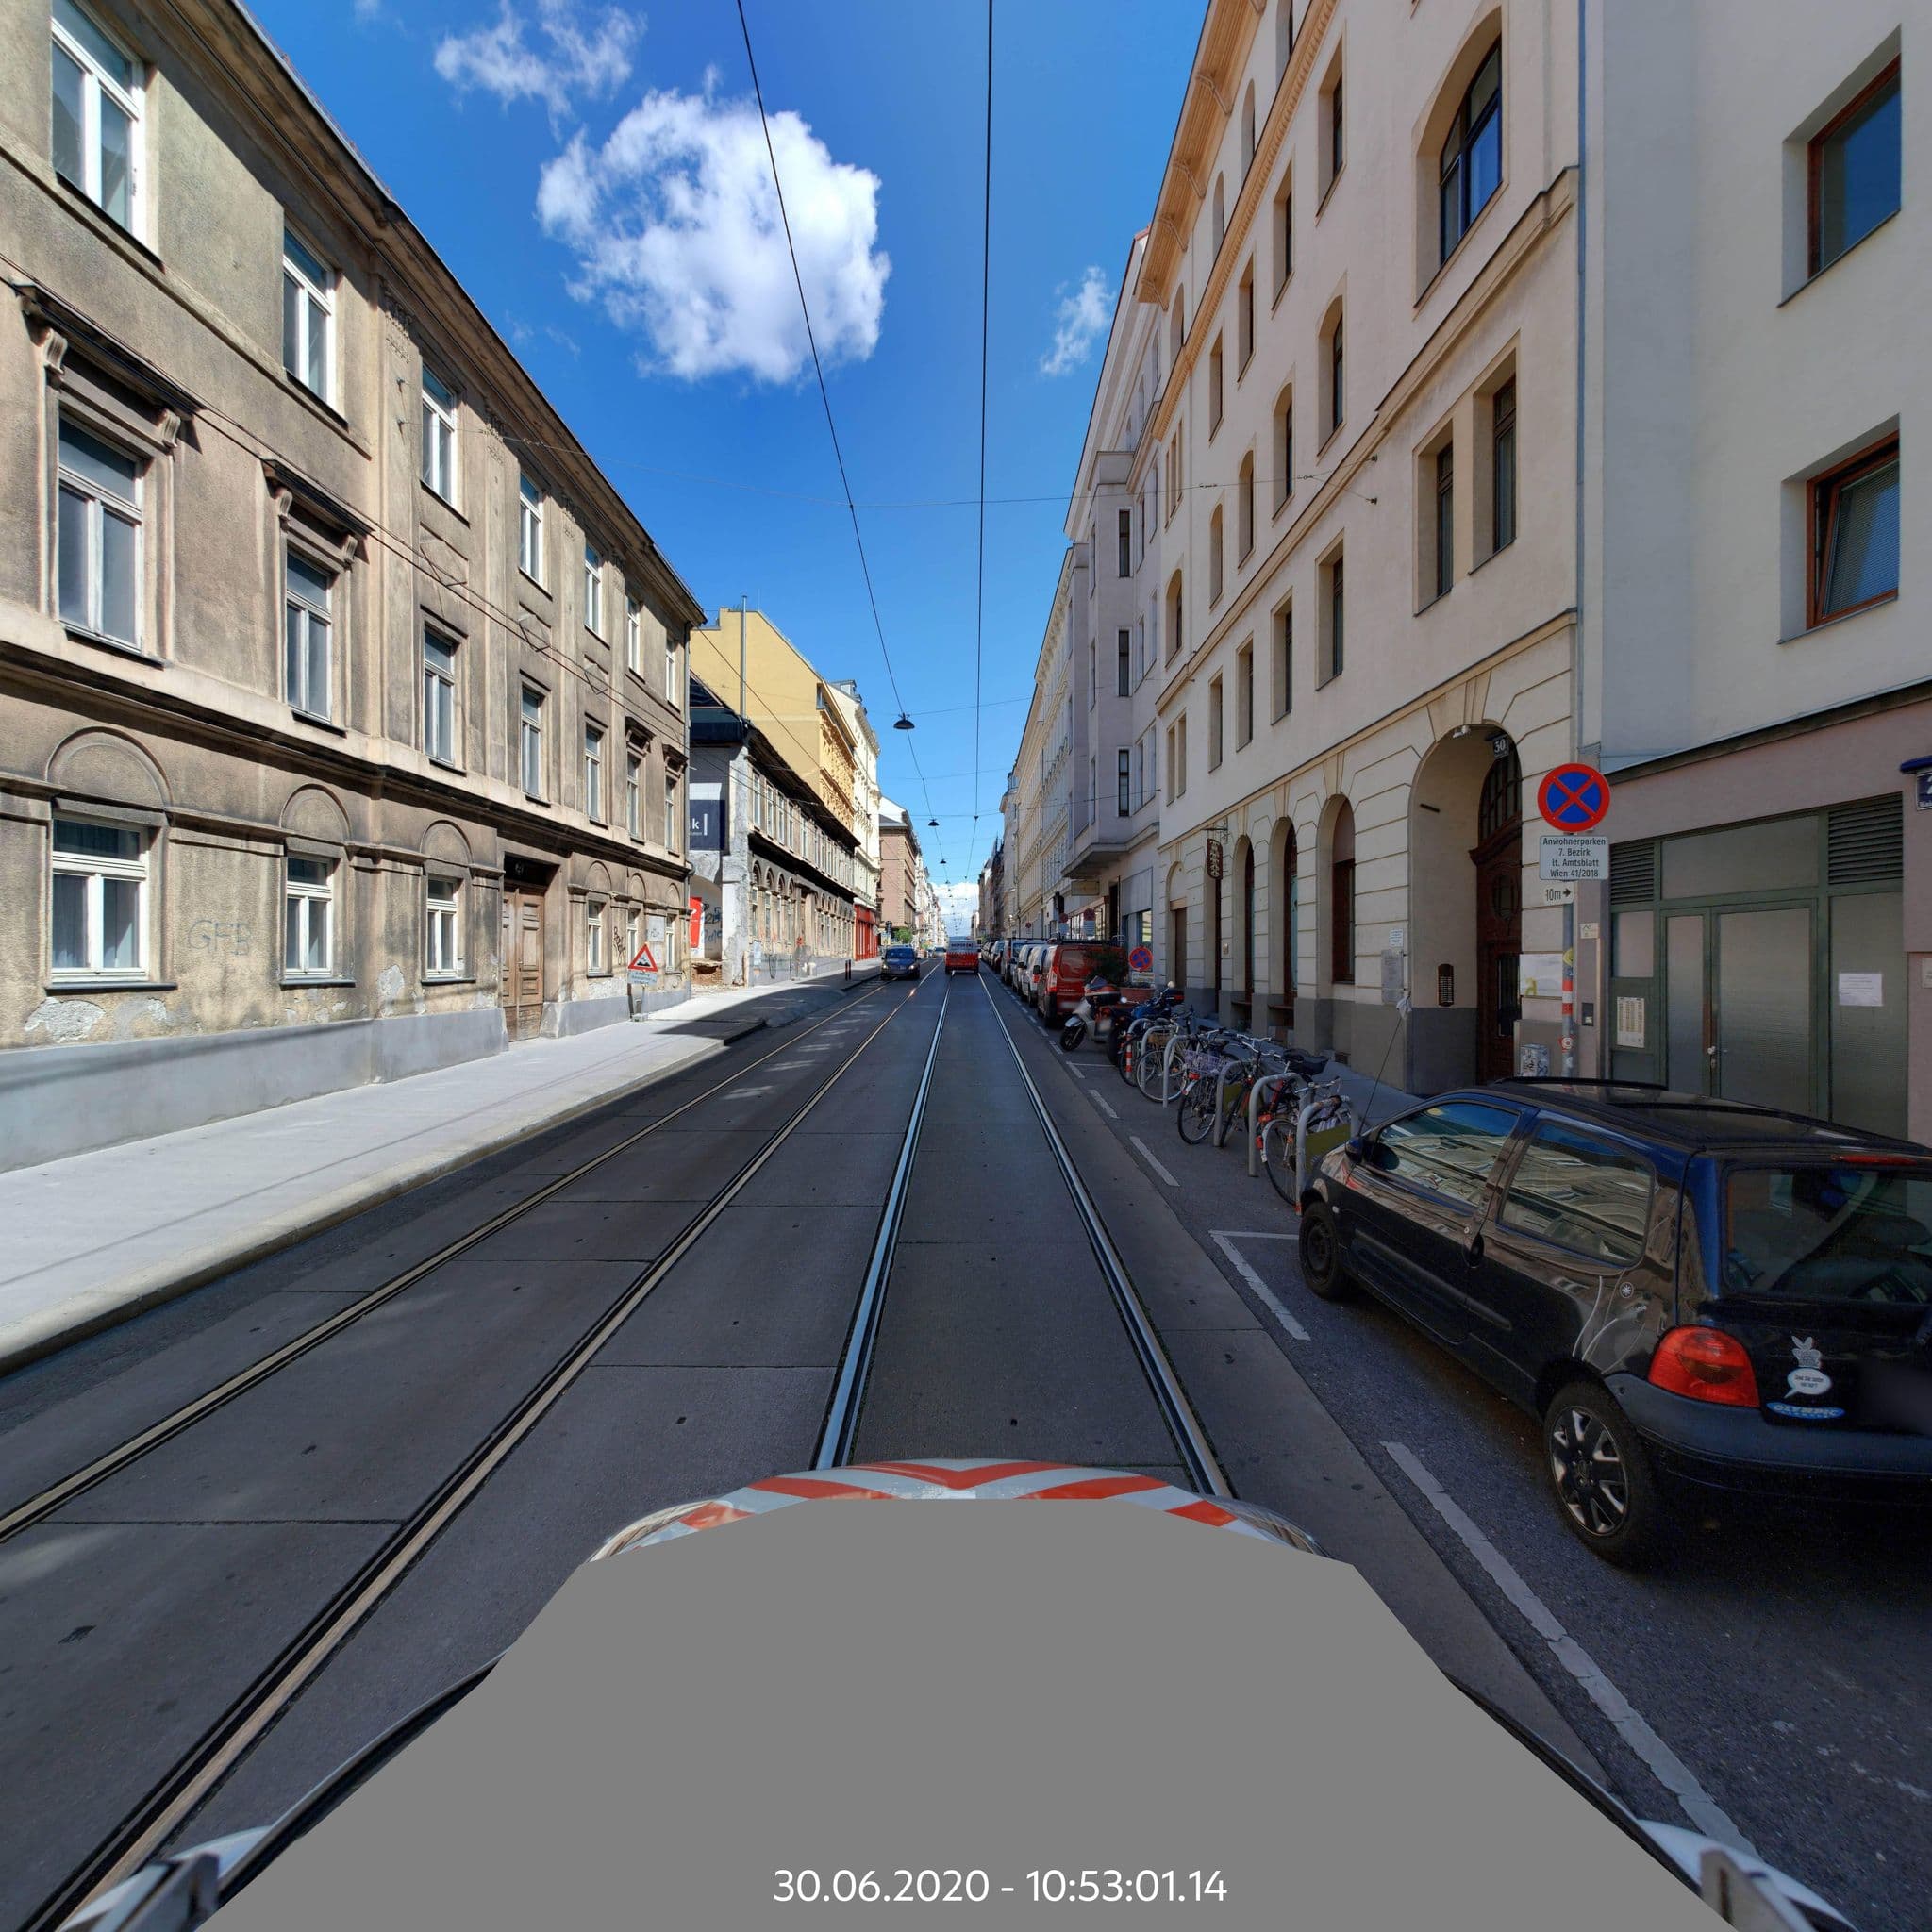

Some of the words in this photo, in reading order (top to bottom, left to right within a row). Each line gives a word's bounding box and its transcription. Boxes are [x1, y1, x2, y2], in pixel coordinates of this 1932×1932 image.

[1542, 837, 1606, 846] Anwohnerparken
[1557, 848, 1565, 857] 7.
[1567, 847, 1591, 857] Bezirk
[1562, 858, 1599, 867] Amtsblatt
[1550, 869, 1568, 877] Wien
[1570, 869, 1599, 878] 41/2018
[1545, 888, 1561, 901] 10m
